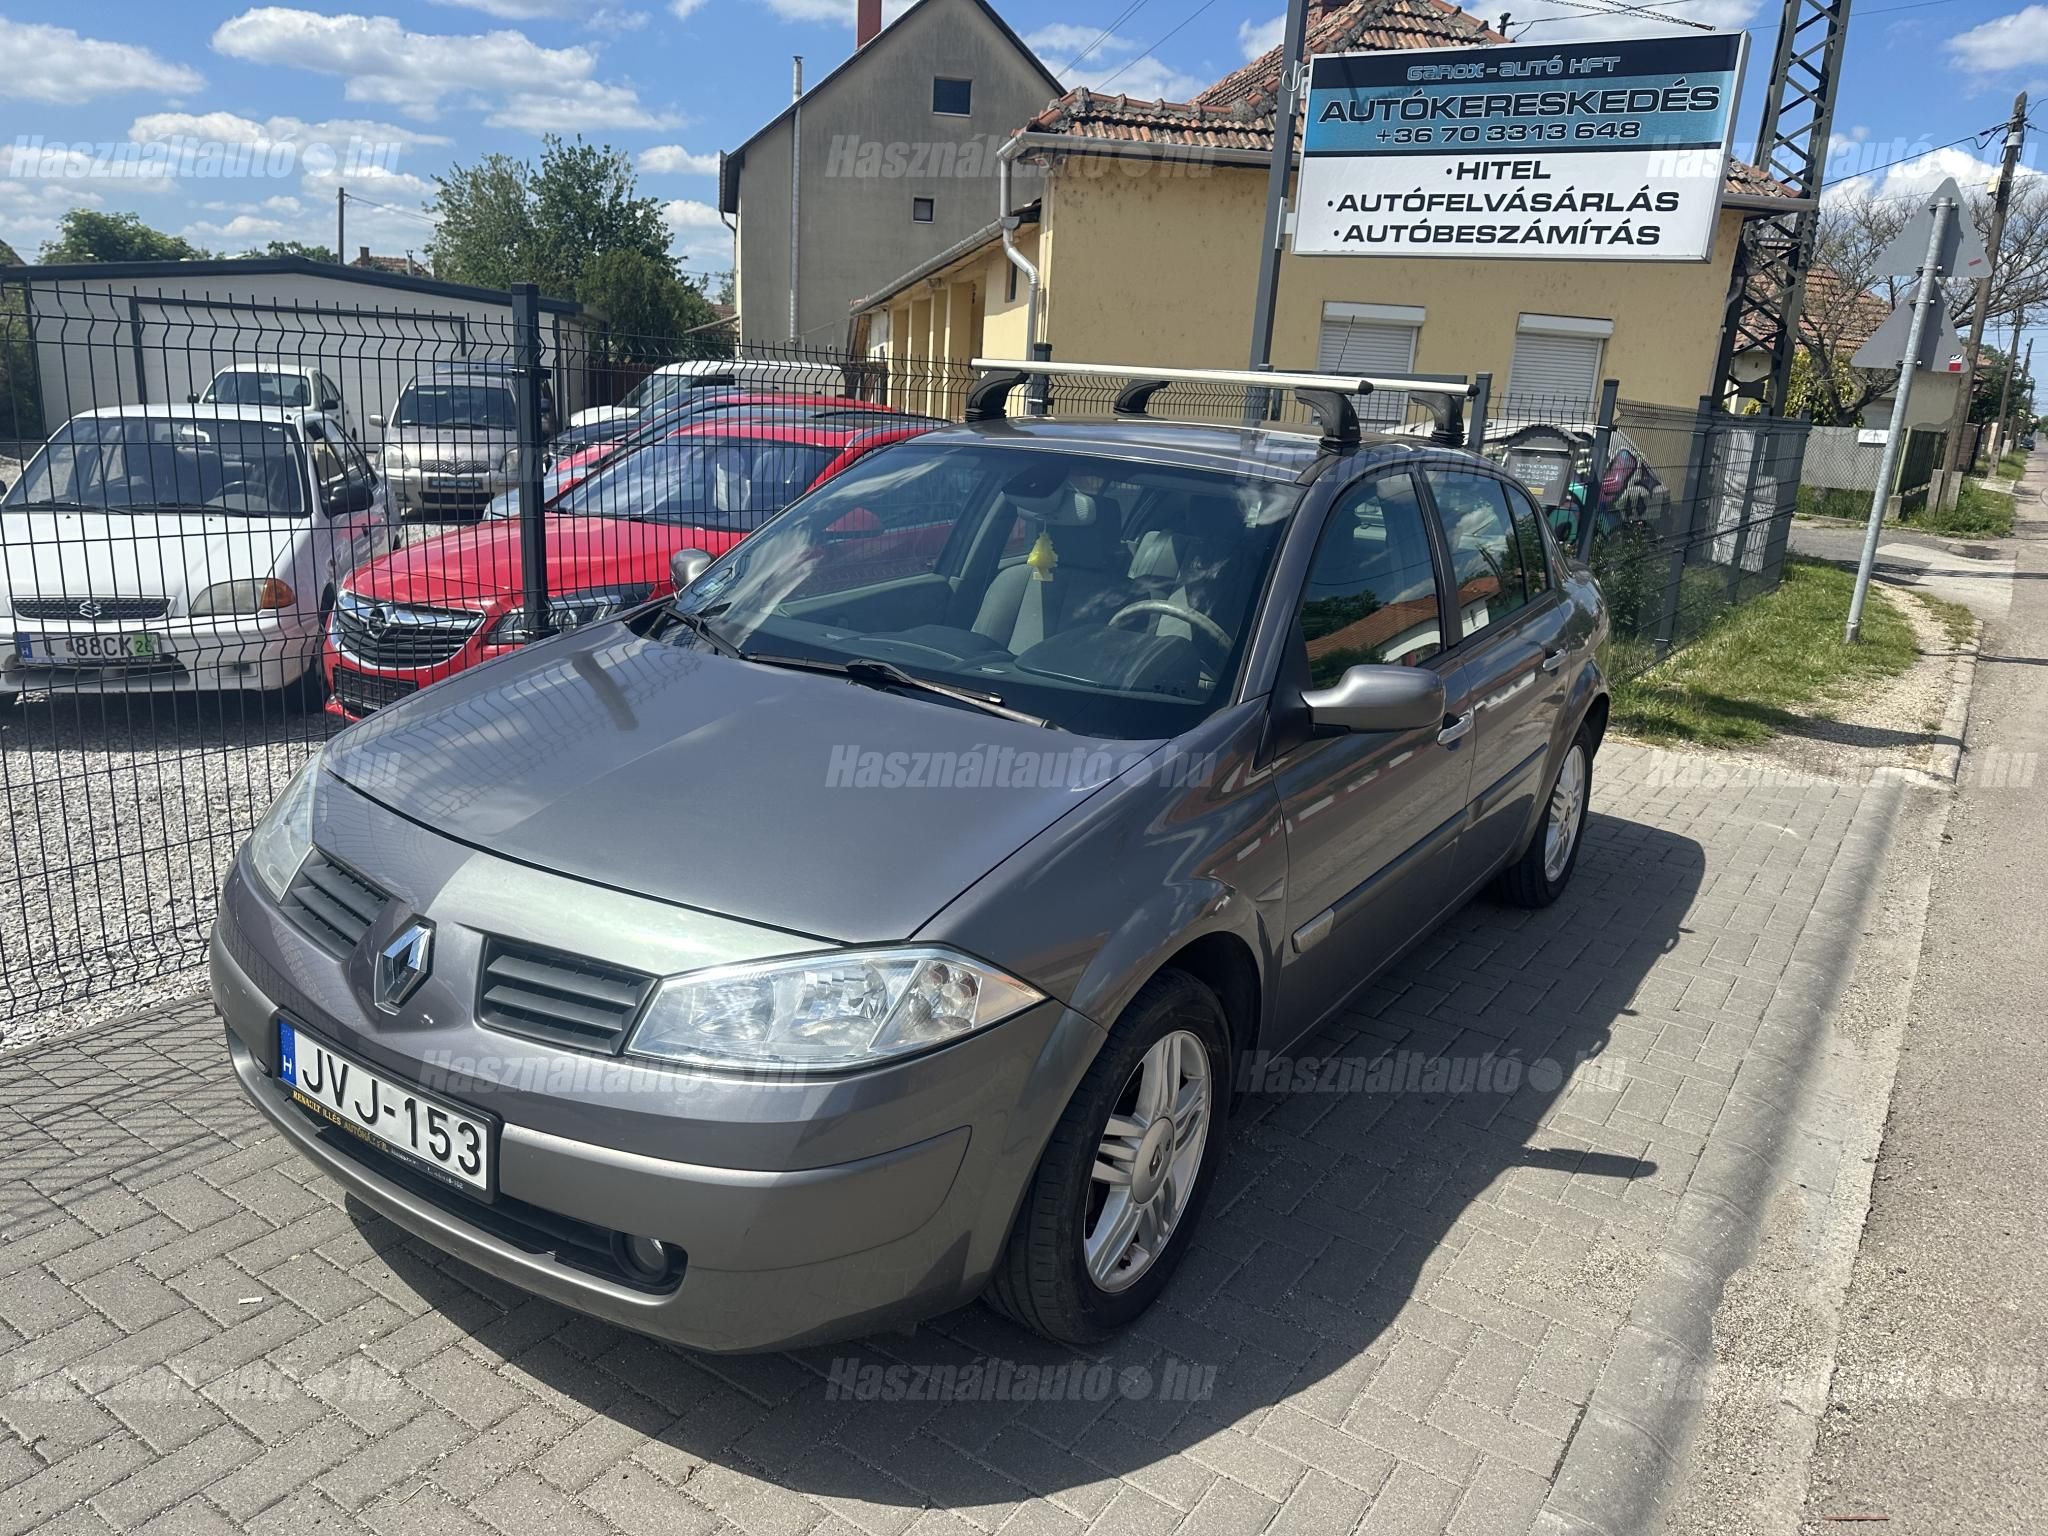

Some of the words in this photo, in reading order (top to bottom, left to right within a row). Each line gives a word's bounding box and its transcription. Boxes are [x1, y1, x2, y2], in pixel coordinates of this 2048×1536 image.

[1318, 78, 1720, 124] AUTÓKERESKEDÉS
[1376, 127, 1432, 144] +36
[1441, 126, 1480, 143] 70
[1486, 123, 1568, 142] 3313
[1574, 121, 1641, 139] 648
[1456, 160, 1551, 181] HITEL
[1336, 184, 1680, 213] AUTÓFELVÁSÁRLÁS
[1342, 217, 1661, 246] AUTÓBESZÁMÍTÁS
[283, 1054, 293, 1075] H
[292, 1090, 321, 1113] RENAULT
[322, 1109, 342, 1126] ILLÉS
[302, 1048, 481, 1176] JVJ-153
